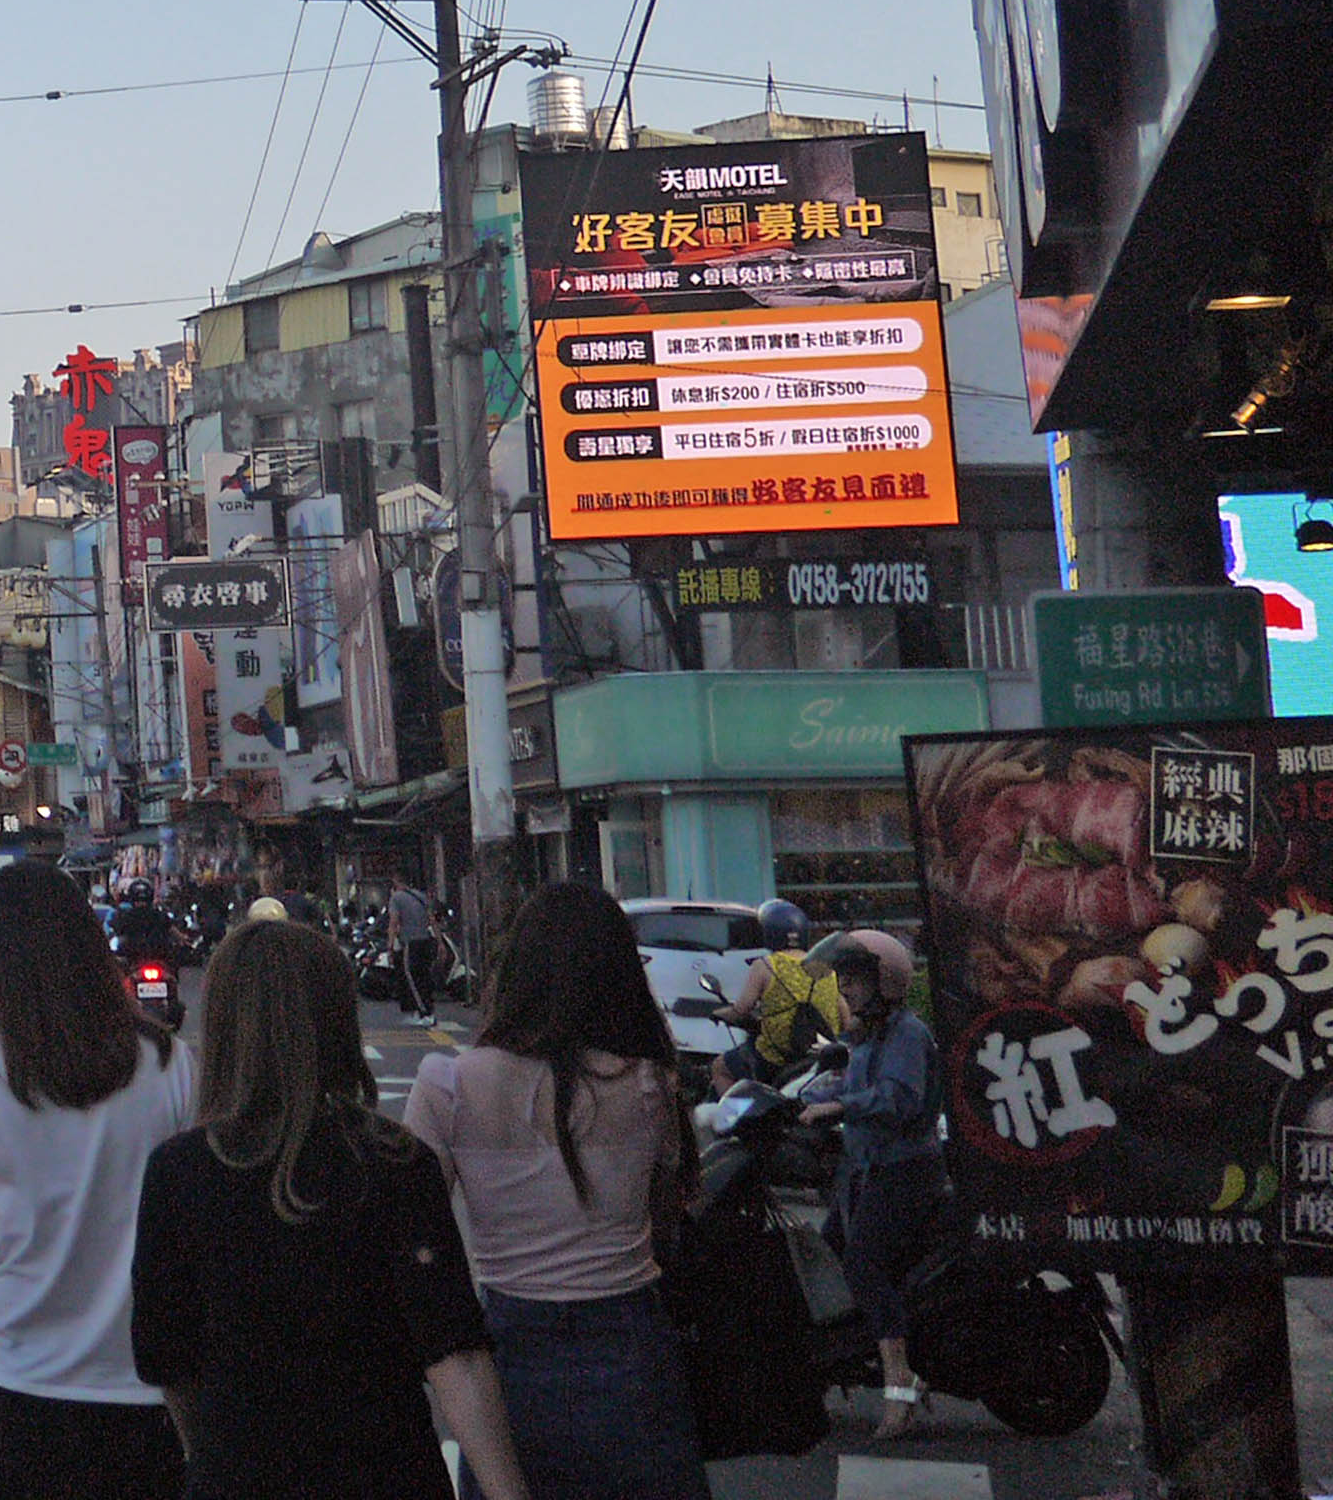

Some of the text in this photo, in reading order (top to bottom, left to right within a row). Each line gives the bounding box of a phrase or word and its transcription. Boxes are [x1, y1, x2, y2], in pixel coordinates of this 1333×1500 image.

[573, 198, 884, 254] 好客友 募集中
[52, 344, 117, 484] 赤鬼
[574, 385, 650, 411] 優惠折扣
[671, 385, 760, 405] 休息折$200
[776, 380, 866, 399] 住宿折$500
[674, 427, 775, 451] 平日住宿5折
[788, 562, 929, 605] 0958-372755
[1162, 759, 1244, 804] 經典
[1162, 805, 1244, 851] 麻辣
[977, 1026, 1116, 1148] 紅
